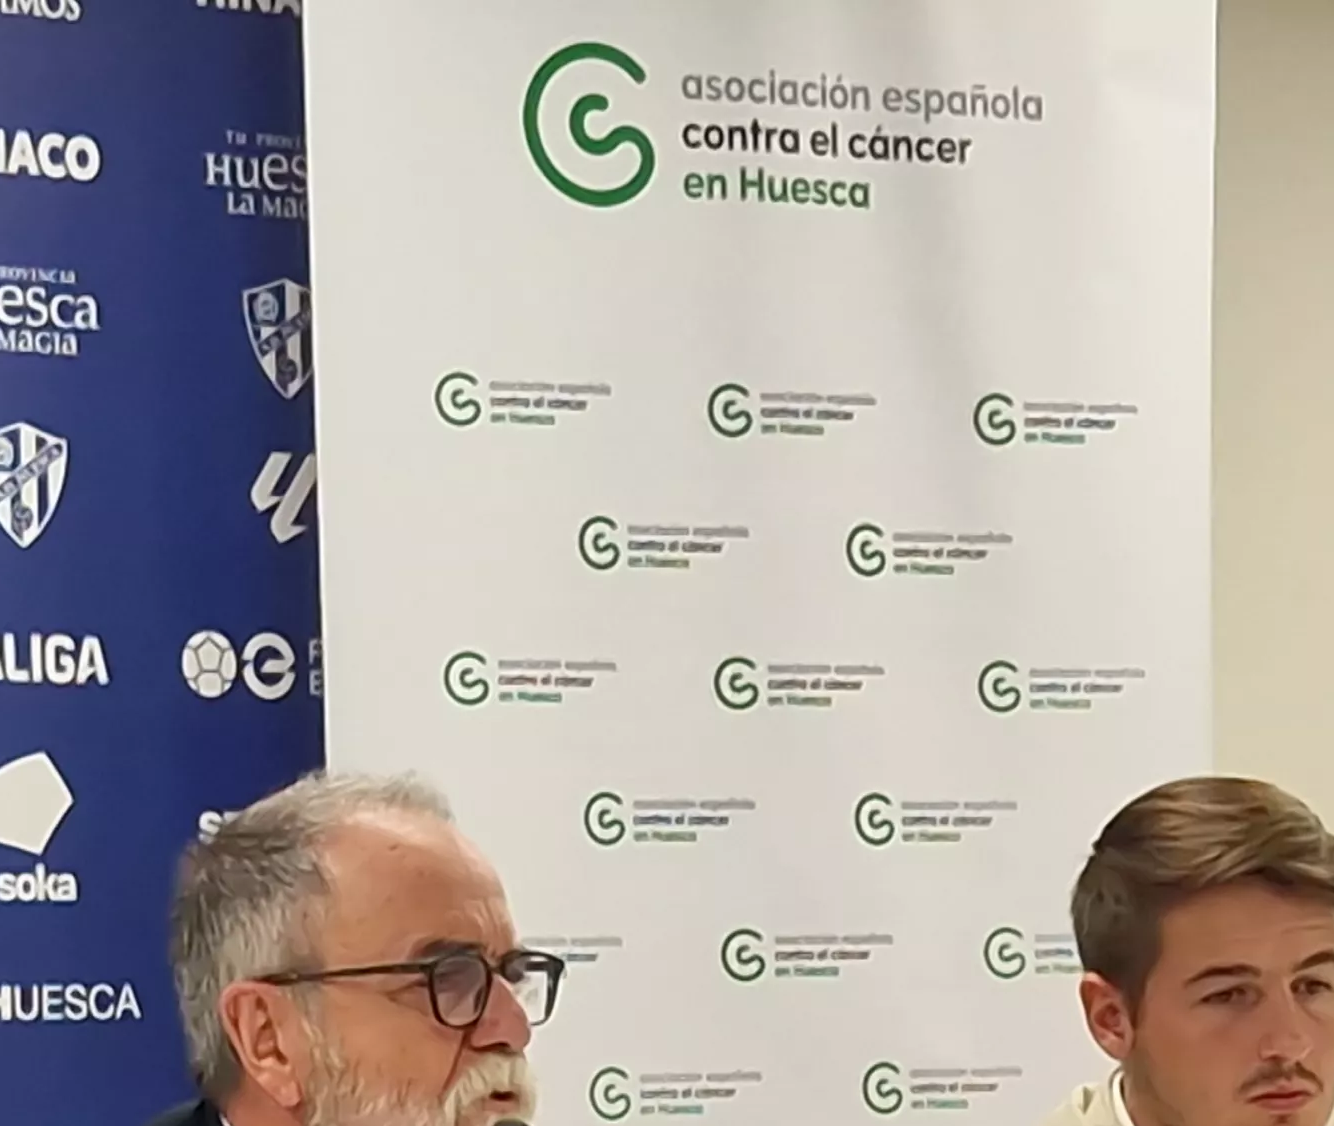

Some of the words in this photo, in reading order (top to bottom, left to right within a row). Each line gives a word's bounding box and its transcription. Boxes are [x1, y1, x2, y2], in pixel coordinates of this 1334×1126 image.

[681, 69, 871, 112] asociación
[881, 84, 1043, 125] española
[681, 118, 800, 154] contra
[809, 121, 839, 158] el
[848, 125, 972, 164] cáncer
[205, 152, 306, 193] Hues
[683, 172, 728, 200] en
[739, 166, 870, 209] Huesca
